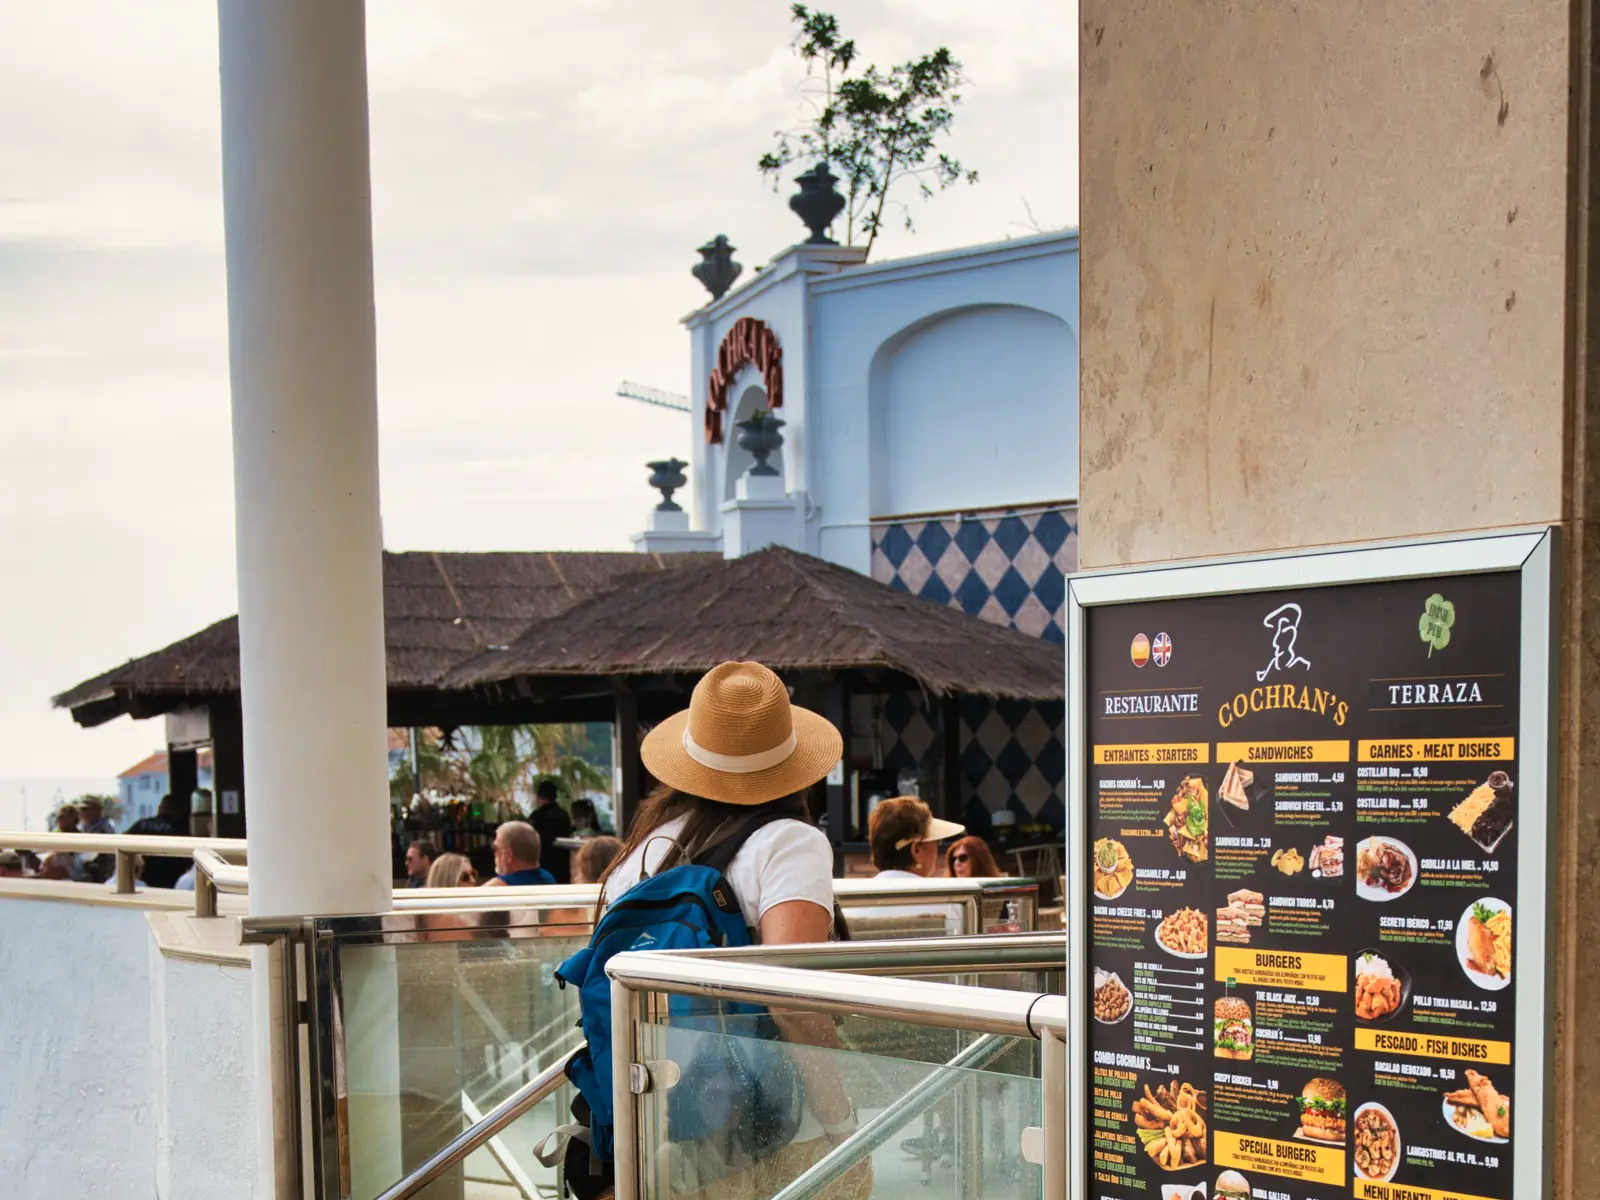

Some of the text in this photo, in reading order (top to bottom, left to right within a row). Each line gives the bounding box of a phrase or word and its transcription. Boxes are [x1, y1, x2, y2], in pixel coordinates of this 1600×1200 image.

[1428, 604, 1449, 622] IRISH
[1427, 622, 1442, 638] PUB
[1389, 682, 1483, 704] TERRAZA
[1105, 694, 1198, 714] RESTAURANTE
[1218, 684, 1349, 728] COCHRAN'S
[1104, 749, 1197, 762] ENTRANTES STARTERS
[1248, 746, 1313, 760] SANDWICHES
[1370, 743, 1500, 758] CARNES MEAT DISHES
[1275, 772, 1344, 783] SANDWICH MIXTO 4,50
[1357, 767, 1428, 779] COSTILLAR 16,90
[1275, 801, 1301, 811] SANDWICH
[1302, 802, 1325, 811] VEGETAL
[1357, 799, 1427, 809] COSTILLAR 16,90
[1216, 837, 1240, 846] SANDWICH
[1241, 838, 1253, 847] CLUB
[1421, 859, 1499, 872] CODILLO A LA MIEL 14,90
[1269, 897, 1295, 906] SANDWICH
[1094, 906, 1146, 917] BACON CHEESE FRIES
[1380, 917, 1453, 931] SECRETO 17,90
[1256, 954, 1301, 969] BURGERS
[1256, 991, 1319, 1006] THE BLACK JACK 12,50
[1413, 995, 1496, 1012] POLLO TIKKA MASALA 12,50
[1375, 1034, 1487, 1058] PESCADO FISH DISHES
[1094, 1051, 1179, 1075] COMBO 14,90
[1375, 1061, 1431, 1077] BACALAO REBOZADO
[1109, 1069, 1114, 1078] DE
[1214, 1073, 1252, 1085] CRISPY CHICKEN
[1102, 1090, 1109, 1098] DE
[1105, 1111, 1111, 1119] DE
[1240, 1139, 1316, 1163] SPECIAL BURGERS
[1407, 1145, 1498, 1168] LANGOSTINOS AL PIL PIL 9,90
[1098, 1173, 1146, 1190] SALSA SAUCE
[1364, 1185, 1389, 1200] MENU
